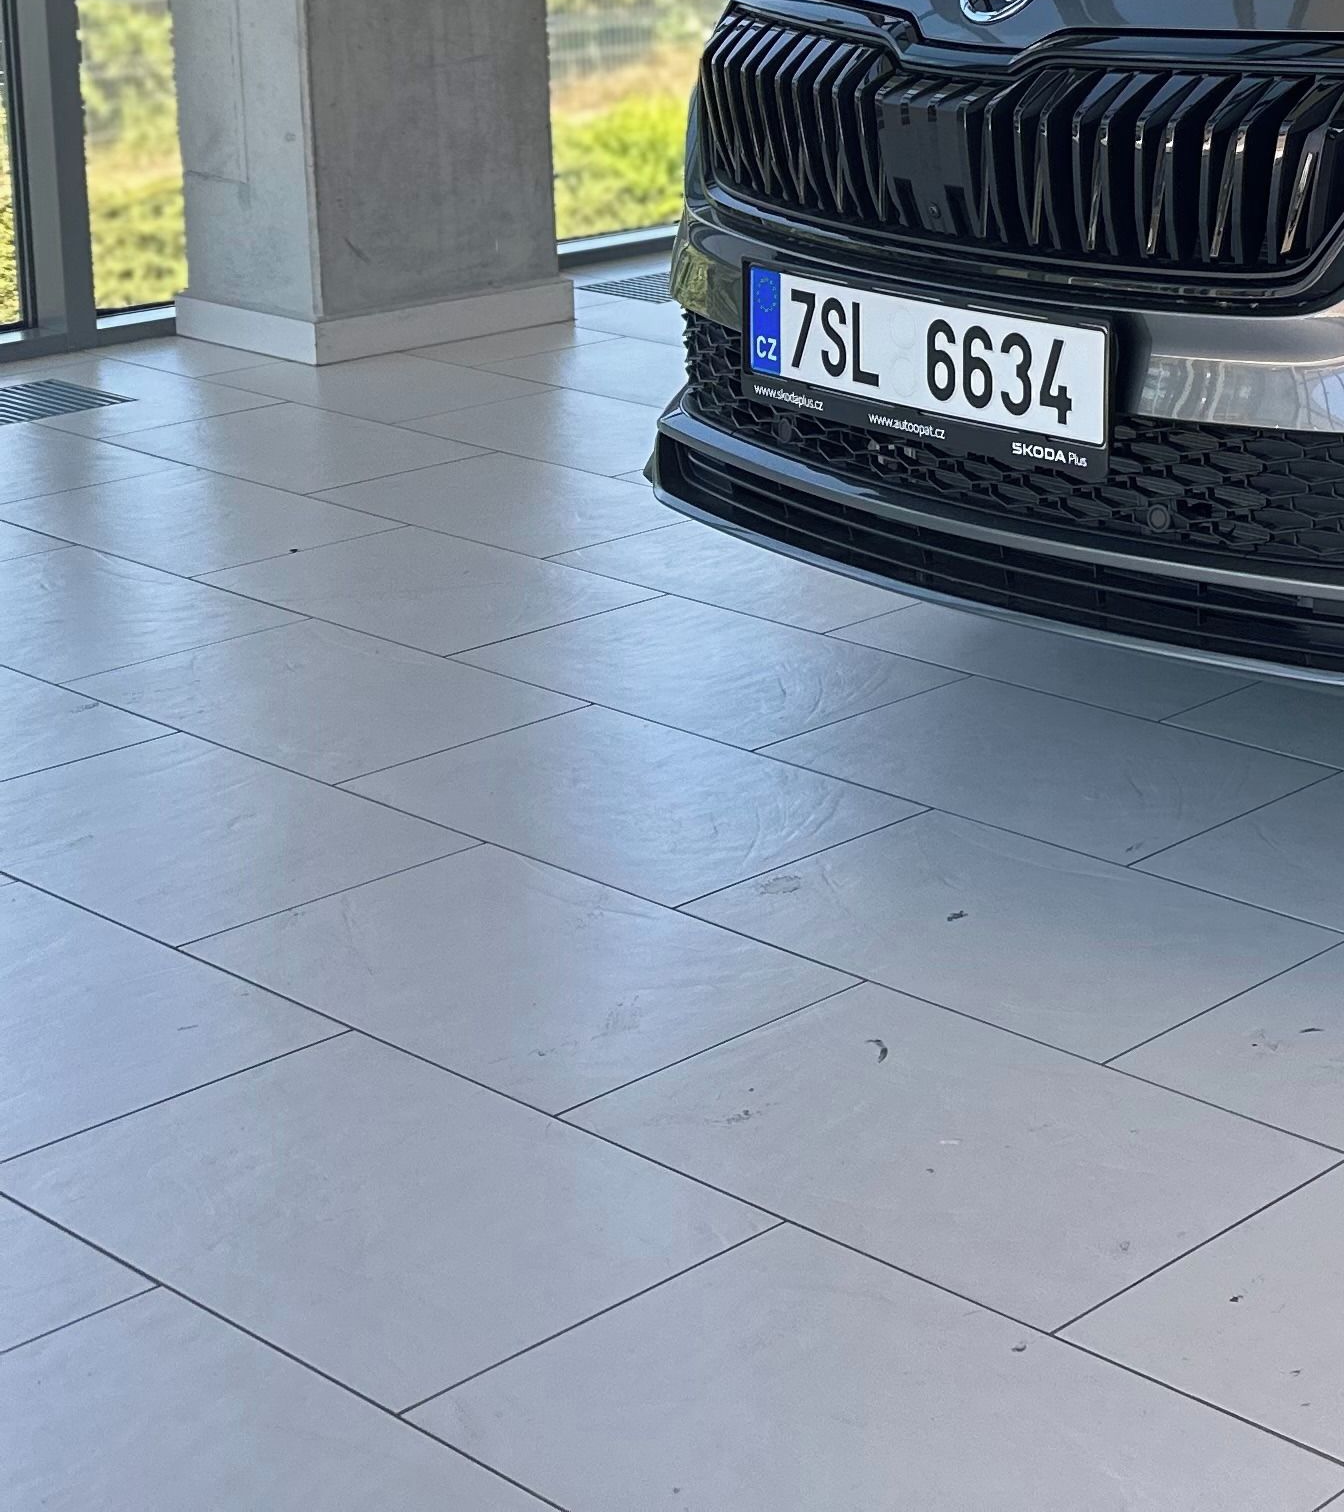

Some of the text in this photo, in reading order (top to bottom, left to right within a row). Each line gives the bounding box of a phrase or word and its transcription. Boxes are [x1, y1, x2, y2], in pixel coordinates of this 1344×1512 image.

[755, 335, 778, 362] CZ
[790, 288, 1073, 426] 7SL 6634
[753, 384, 824, 412] www.skodaplus.cz
[867, 413, 946, 440] www.autoopat.cz
[1067, 451, 1088, 468] Plus
